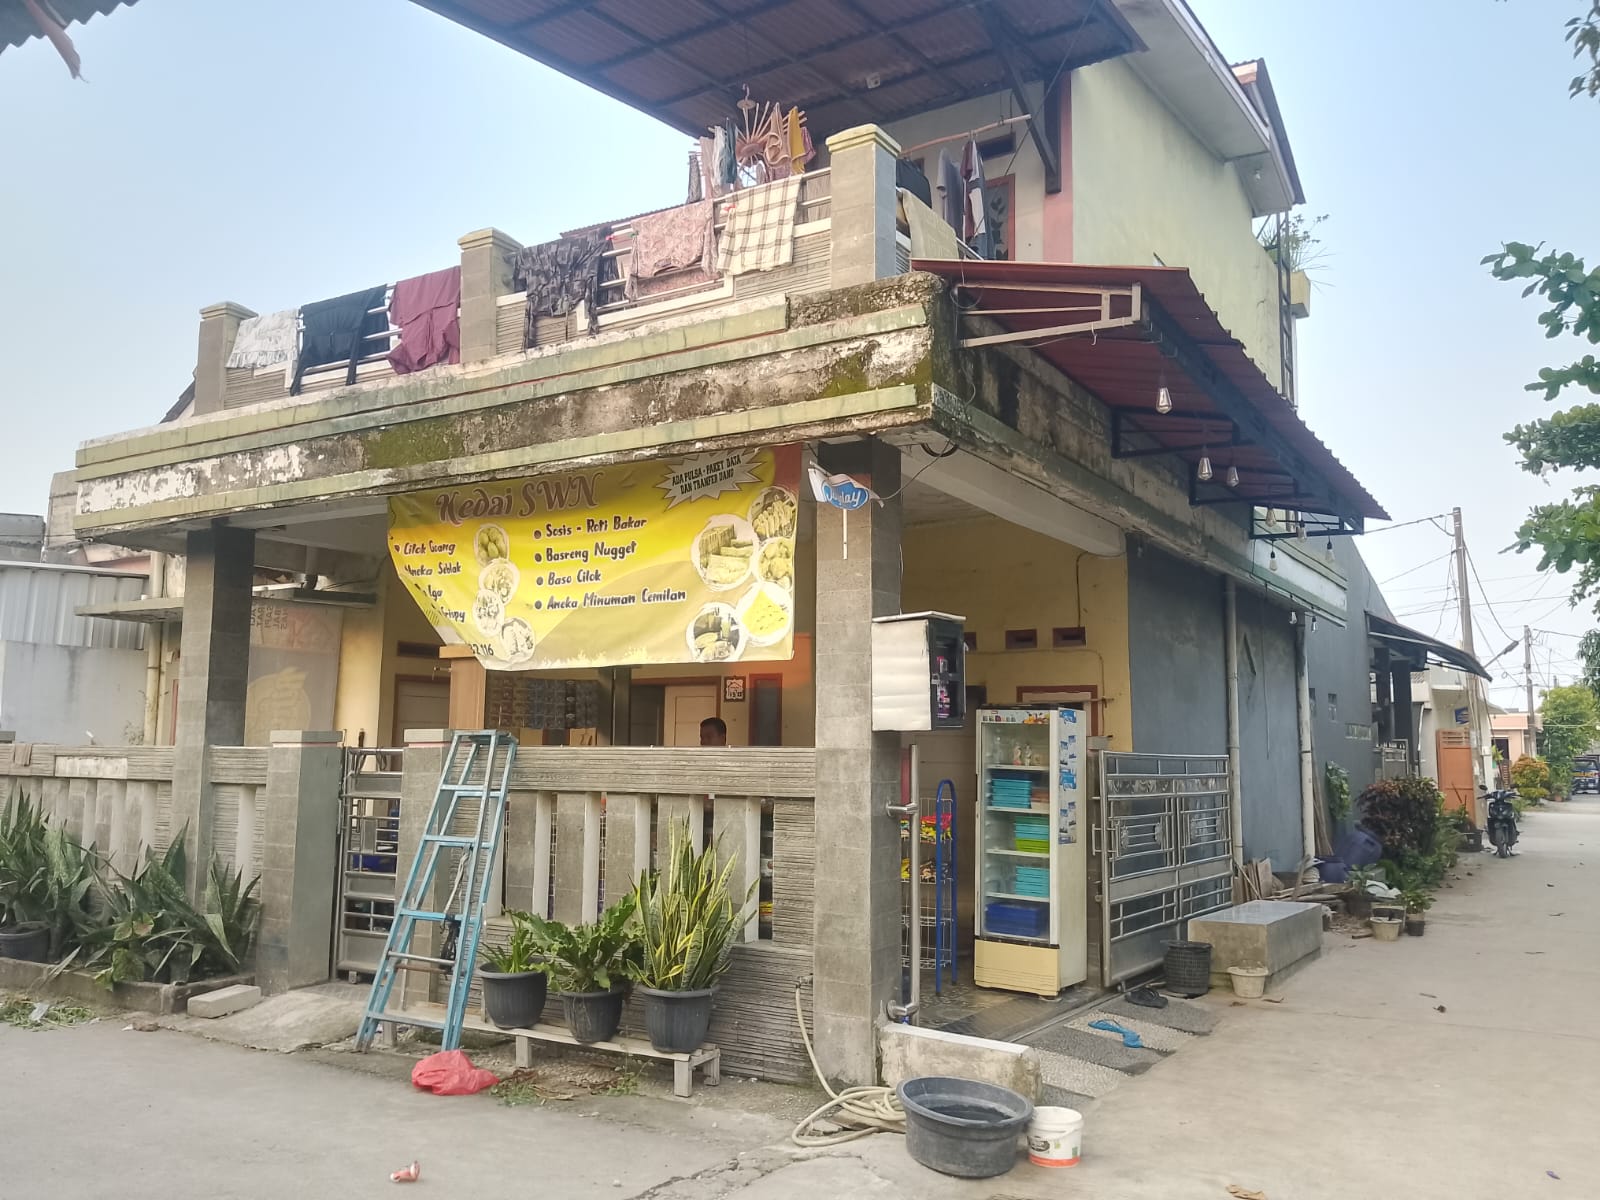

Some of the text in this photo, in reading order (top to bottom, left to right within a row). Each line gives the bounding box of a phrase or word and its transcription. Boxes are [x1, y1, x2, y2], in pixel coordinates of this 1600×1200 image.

[672, 473, 684, 486] ADA
[684, 467, 702, 482] PULSA
[706, 460, 723, 475] PAKET
[726, 454, 741, 468] DATA
[680, 482, 692, 494] DAN
[719, 467, 734, 482] UANG
[436, 472, 603, 526] Kedai SWN
[545, 523, 572, 538] Sosis
[586, 518, 608, 533] Roti
[613, 515, 647, 531] Bakar
[404, 542, 426, 555] Cilok
[546, 540, 638, 563] Basreng Nugget
[438, 561, 461, 574] Seblak
[547, 569, 602, 586] Baso Cilok
[546, 587, 687, 611] Aneka Minuman Cemilan
